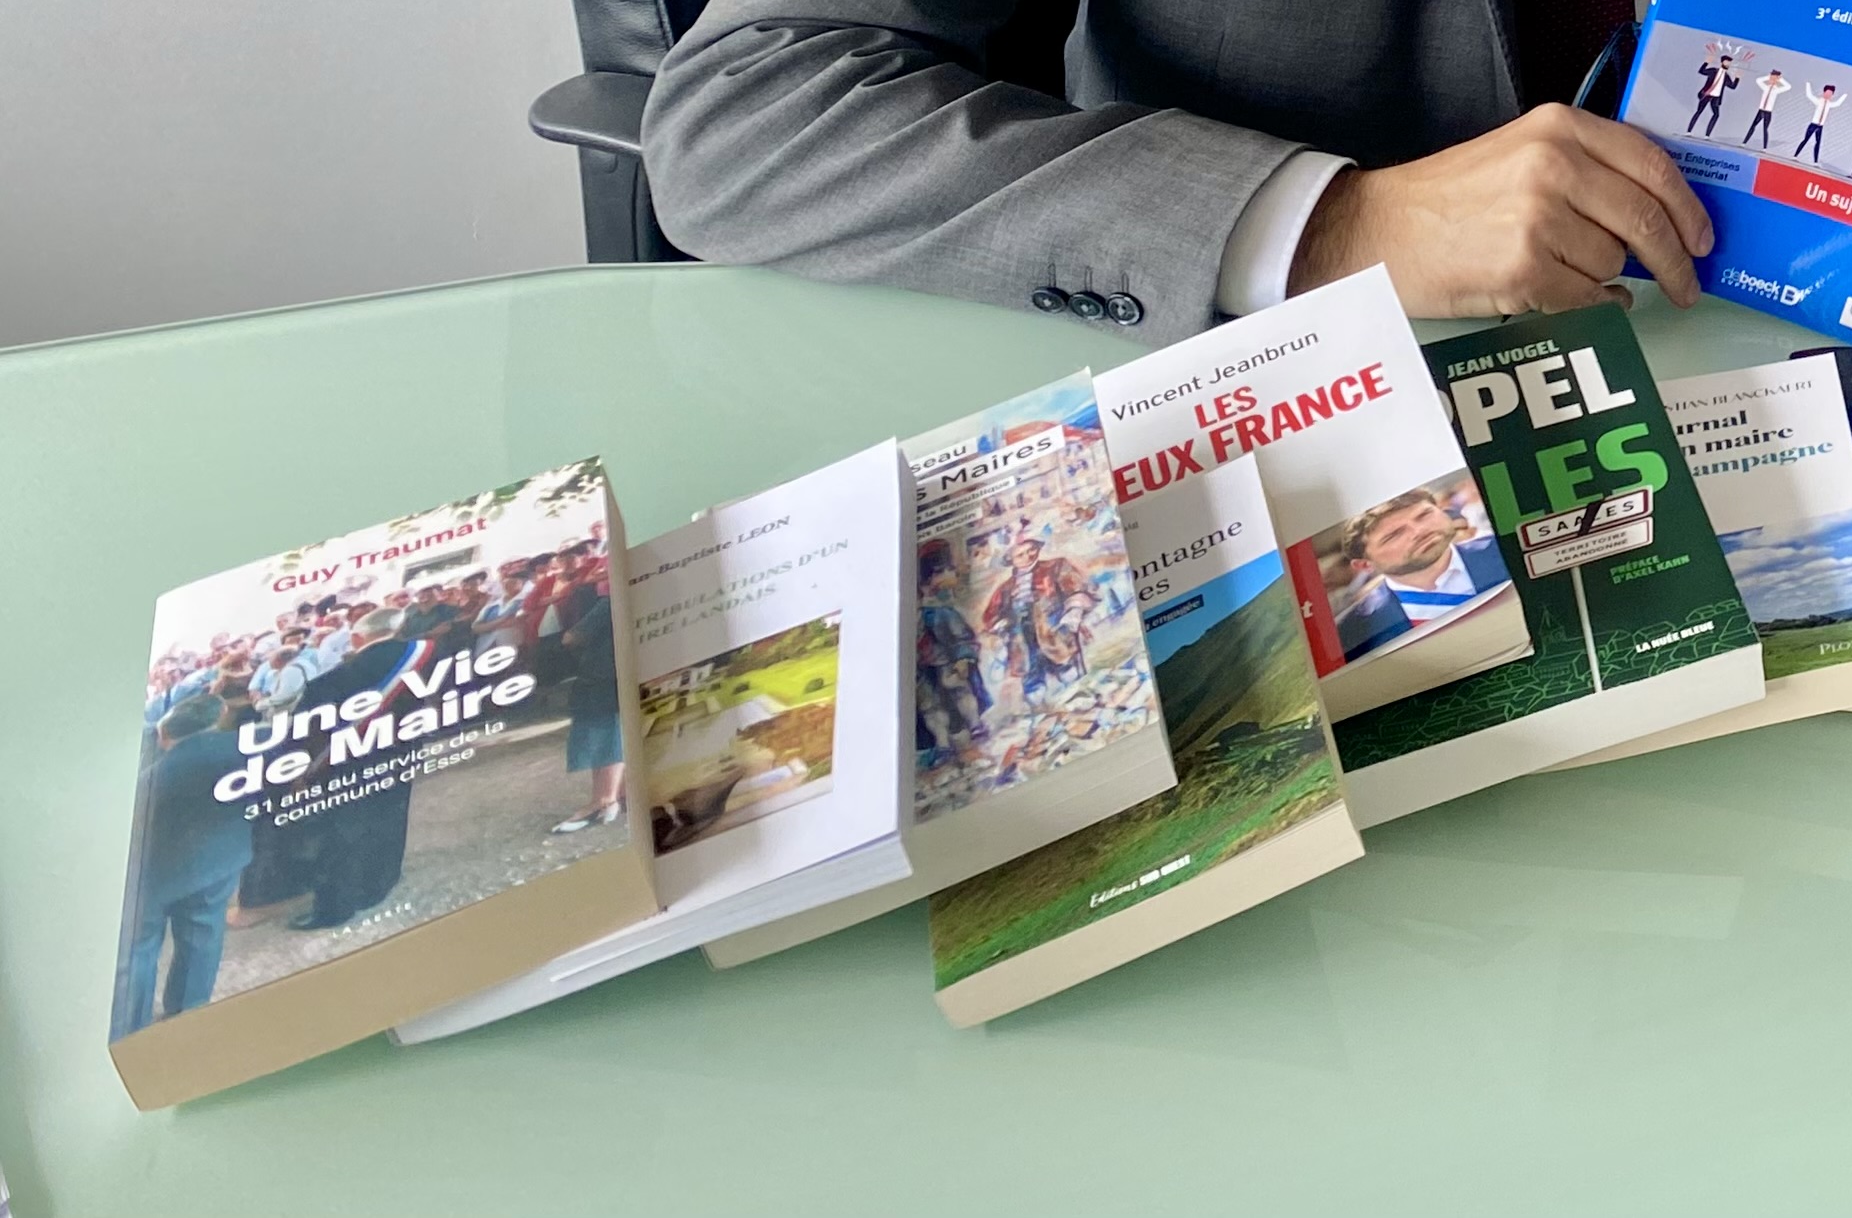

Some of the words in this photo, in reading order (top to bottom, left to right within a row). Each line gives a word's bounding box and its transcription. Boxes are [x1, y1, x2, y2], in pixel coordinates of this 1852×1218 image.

[1805, 182, 1827, 202] Un
[1112, 375, 1203, 421] Vincent
[1208, 332, 1320, 385] Jeanbrun
[1446, 353, 1495, 380] JEAN
[1498, 338, 1561, 367] VOGEL
[1194, 385, 1258, 429] LES
[1450, 346, 1636, 448] PEL
[1113, 439, 1203, 504] EUX
[1208, 362, 1393, 465] FRANCE
[1692, 442, 1834, 477] ampagne
[1705, 427, 1794, 453] maire
[941, 437, 1052, 490] Maires
[272, 565, 340, 595] Guy
[348, 516, 488, 569] Traumat
[737, 515, 791, 544] LEON
[1132, 521, 1243, 582] ontagne
[1609, 554, 1660, 575] PRÉFACE
[1657, 554, 1690, 573] KAHN
[634, 561, 793, 630] TRIBULATIONS
[681, 584, 777, 628] LANDAIS
[1636, 641, 1651, 653] LA
[1680, 620, 1715, 639] BLEUE
[238, 689, 384, 756] Une
[399, 644, 518, 700] Vie
[213, 750, 311, 803] de
[329, 673, 537, 767] Maire
[243, 800, 274, 821] 31
[280, 784, 323, 807] ans
[328, 772, 356, 792] au
[363, 744, 444, 779] service
[450, 731, 479, 750] de
[484, 720, 505, 737] la
[274, 779, 394, 827] commune
[399, 748, 476, 784] d'Esse
